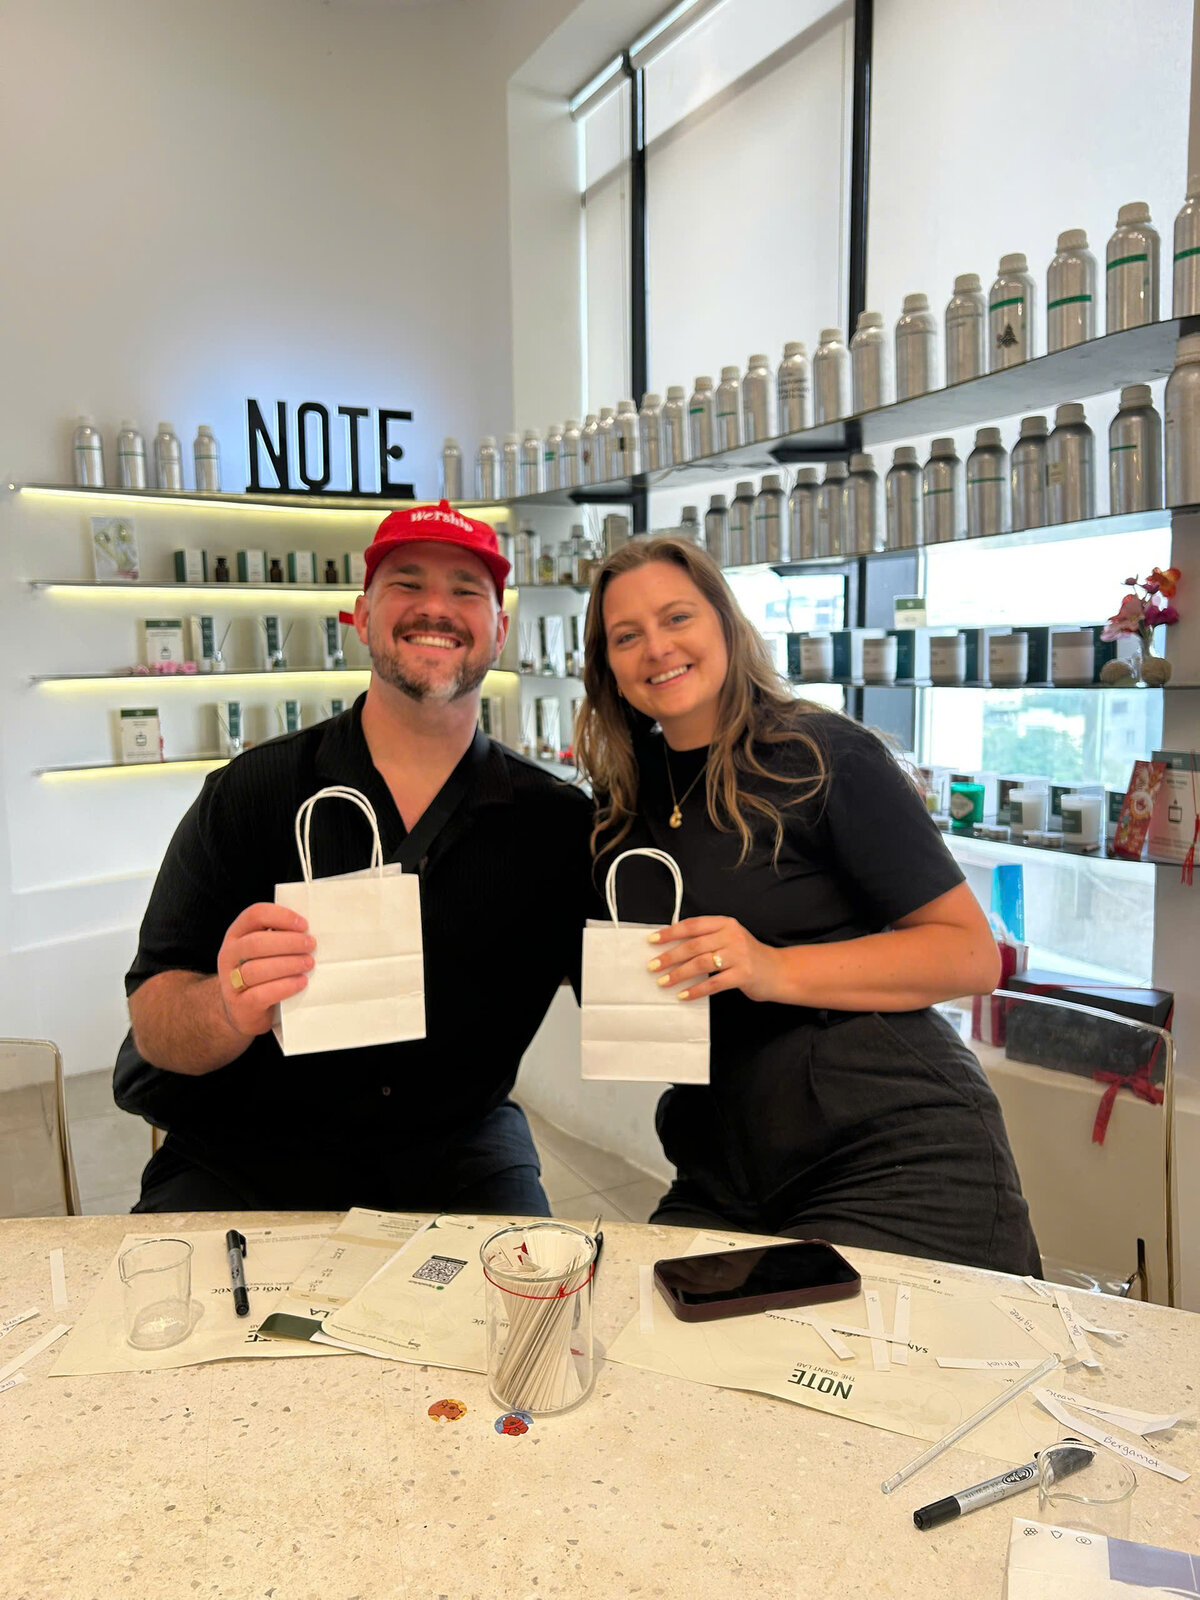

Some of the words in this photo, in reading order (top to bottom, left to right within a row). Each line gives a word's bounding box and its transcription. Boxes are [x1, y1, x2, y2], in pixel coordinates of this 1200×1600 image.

[246, 398, 415, 499] NOTE
[1009, 1308, 1024, 1324] tree
[1023, 1319, 1036, 1333] Fig
[796, 1361, 812, 1370] LAB
[813, 1366, 840, 1377] SCENT
[787, 1368, 853, 1400] NOTE
[841, 1373, 856, 1382] THE
[1103, 1436, 1160, 1467] Bergamot
